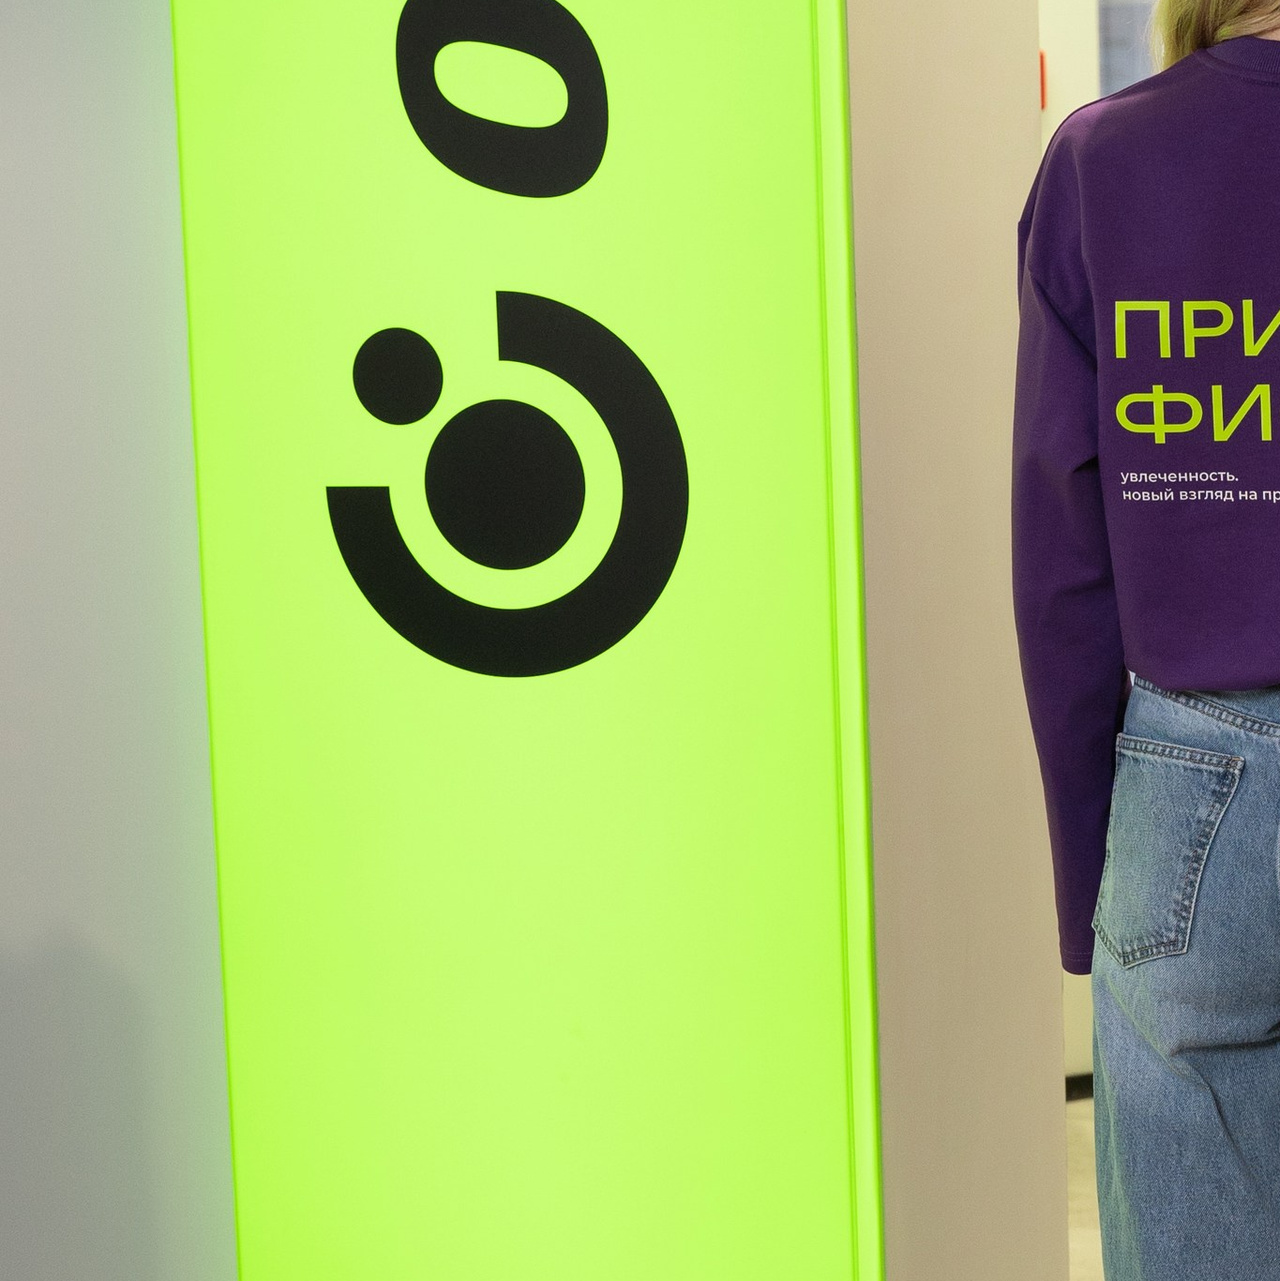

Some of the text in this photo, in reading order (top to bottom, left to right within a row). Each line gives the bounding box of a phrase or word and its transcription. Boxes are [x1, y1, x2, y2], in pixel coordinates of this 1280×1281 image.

[1120, 470, 1239, 484] увлеченность.
[1122, 488, 1175, 502] новый
[1179, 489, 1235, 503] взгляд
[1238, 490, 1258, 501] на
